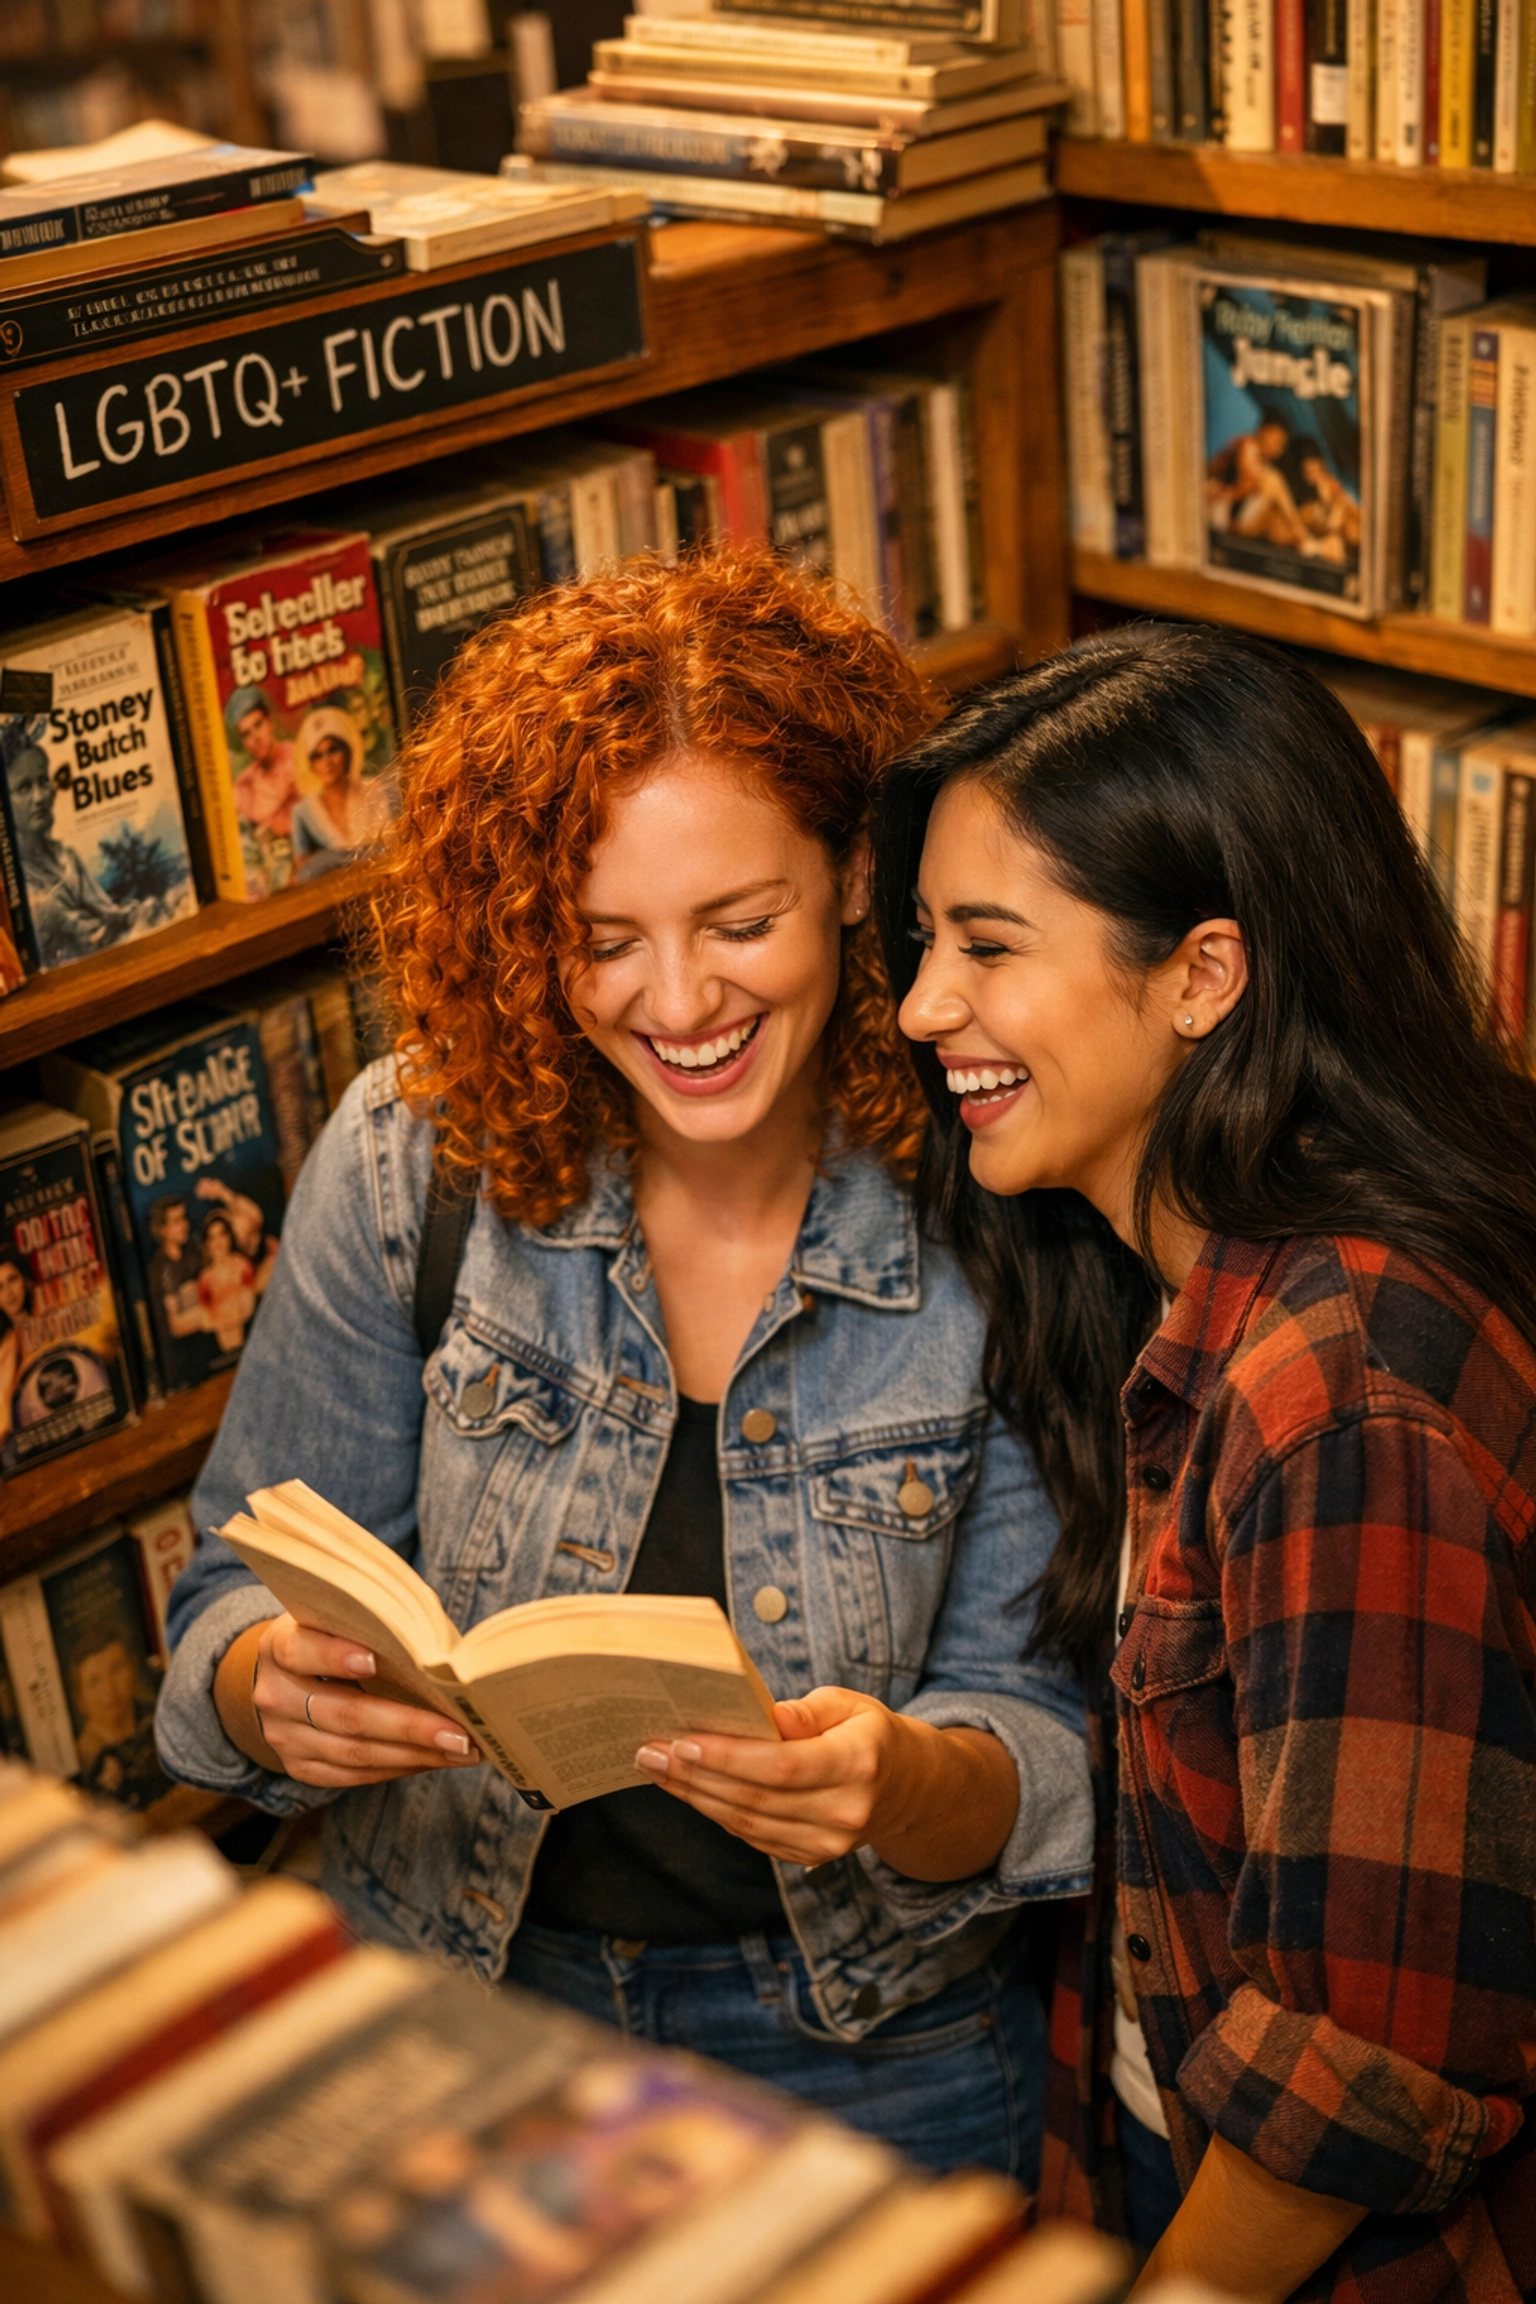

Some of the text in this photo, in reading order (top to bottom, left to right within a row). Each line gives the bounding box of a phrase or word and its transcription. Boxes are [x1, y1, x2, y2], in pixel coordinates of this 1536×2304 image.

[55, 352, 309, 481] LGBTQ+
[323, 278, 567, 414] FICTION
[49, 687, 154, 743] Stoney
[74, 722, 147, 771] Butch
[72, 763, 154, 813] Blues
